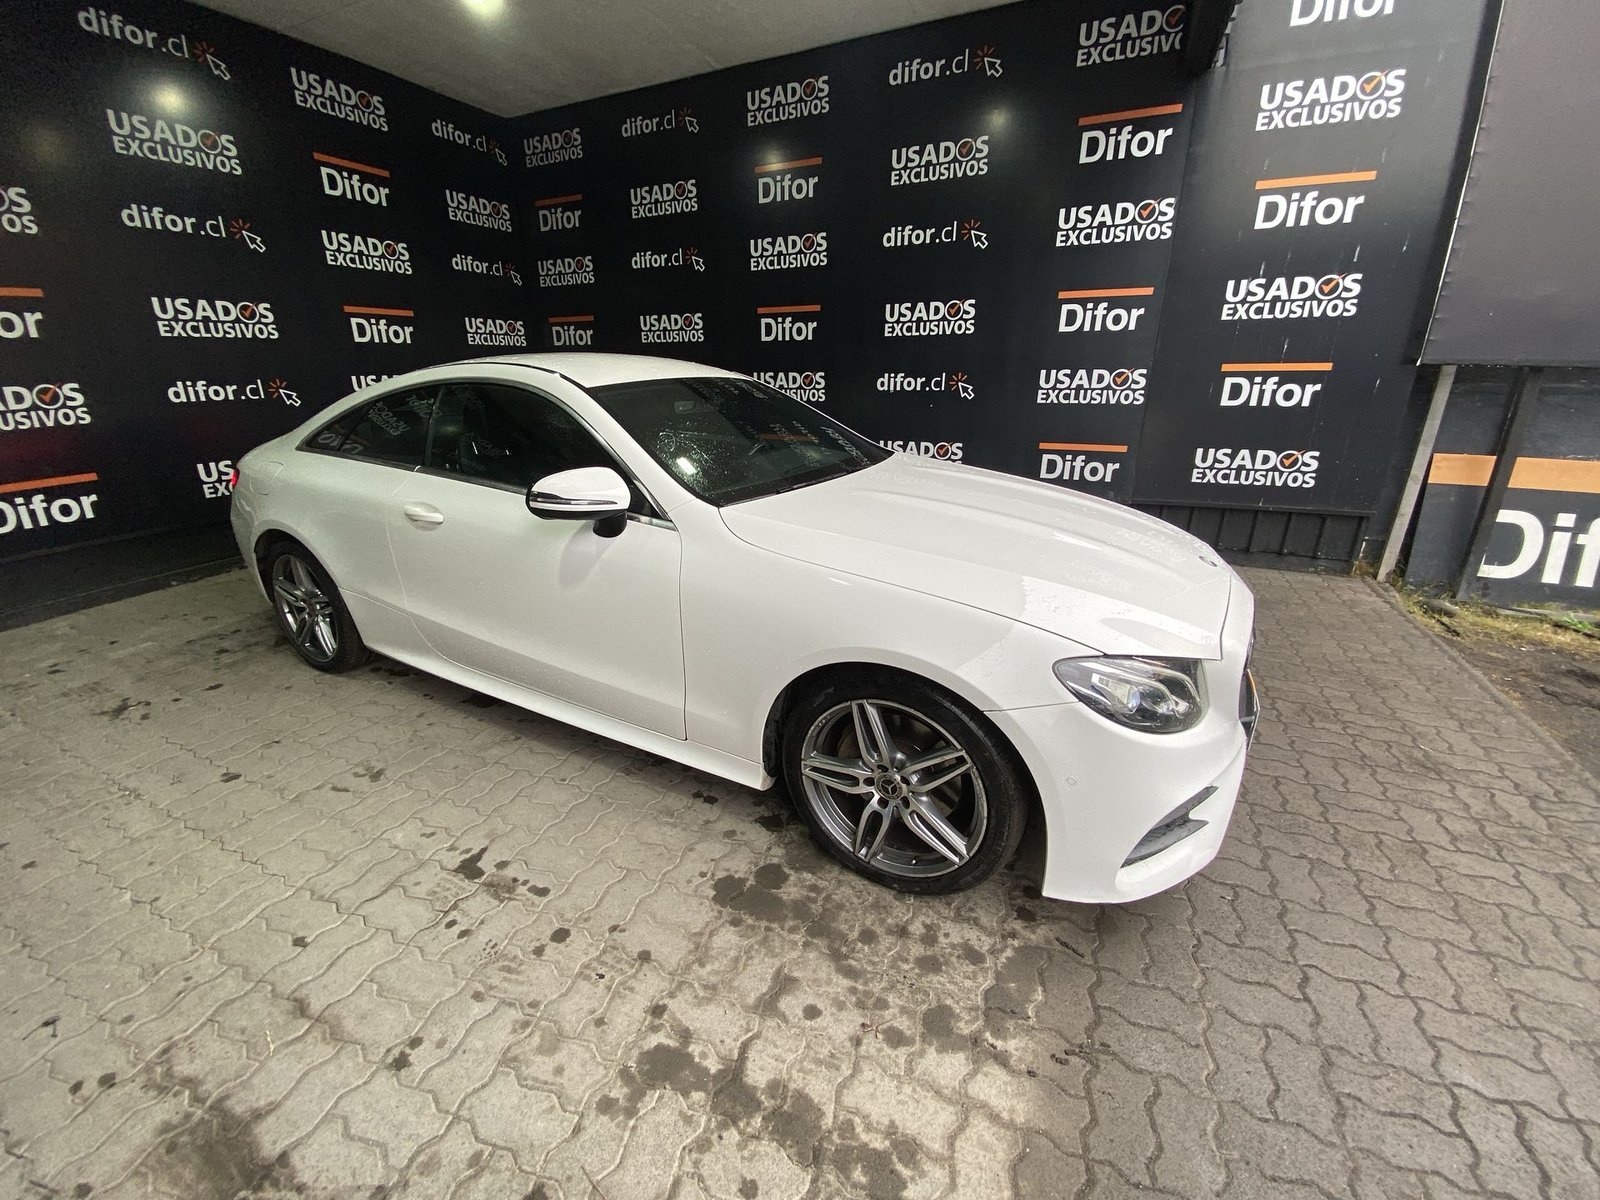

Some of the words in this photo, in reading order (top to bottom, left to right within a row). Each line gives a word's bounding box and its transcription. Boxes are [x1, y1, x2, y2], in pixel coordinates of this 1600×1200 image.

[78, 8, 188, 58] difor.cl
[888, 49, 969, 86] difor.cl
[291, 67, 385, 116] USADOS
[746, 75, 830, 111] USADOS
[1260, 69, 1406, 110] USADOS
[295, 91, 388, 132] EXCLUSIVOS
[621, 109, 676, 138] difor.cl
[747, 98, 830, 127] EXCLUSIVOS
[1255, 98, 1402, 131] EXCLUSIVOS
[107, 109, 238, 157] USADOS
[431, 119, 487, 152] difor.cl
[523, 128, 581, 156] USADOS
[1079, 125, 1173, 164] Difor
[112, 135, 242, 175] EXCLUSIVOS
[526, 146, 583, 168] EXCLUSIVOS
[891, 135, 989, 170] USADOS
[890, 158, 989, 186] EXCLUSIVOS
[321, 166, 389, 207] Difor
[630, 179, 697, 205] USADOS
[757, 174, 819, 204] Difor
[446, 189, 510, 220] USADOS
[631, 198, 698, 219] EXCLUSIVOS
[1058, 197, 1175, 230] USADOS
[1254, 191, 1365, 230] Difor
[121, 205, 227, 239] difor.cl
[448, 207, 512, 232] EXCLUSIVOS
[538, 208, 582, 232] Difor
[321, 230, 410, 260] USADOS
[750, 232, 828, 257] USADOS
[882, 220, 957, 248] difor.cl
[1055, 222, 1172, 247] EXCLUSIVOS
[325, 251, 412, 275] EXCLUSIVOS
[452, 254, 503, 276] difor.cl
[538, 255, 593, 276] USADOS
[631, 248, 683, 269] difor.cl
[750, 252, 828, 272] EXCLUSIVOS
[539, 272, 595, 288] EXCLUSIVOS
[1225, 273, 1363, 303] USADOS
[151, 297, 274, 324] USADOS
[640, 313, 703, 332] USADOS
[885, 299, 976, 322] USADOS
[1058, 302, 1145, 333] Difor
[1221, 299, 1358, 320] EXCLUSIVOS
[158, 321, 279, 340] EXCLUSIVOS
[350, 317, 414, 344] Difor
[465, 317, 524, 335] USADOS
[552, 326, 593, 346] Difor
[641, 329, 704, 344] EXCLUSIVOS
[760, 317, 817, 342] Difor
[884, 320, 975, 337] EXCLUSIVOS
[467, 333, 527, 347] EXCLUSIVOS
[168, 379, 265, 404] difor.cl
[876, 372, 946, 391] difor.cl
[1039, 368, 1147, 390] USADOS
[1220, 376, 1321, 407] Difor
[0, 383, 85, 411] DOS
[1037, 390, 1145, 405] EXCLUSIVOS
[1040, 454, 1120, 482] Difor
[1194, 447, 1320, 473] USADOS
[1191, 469, 1316, 488] EXCLUSIVOS
